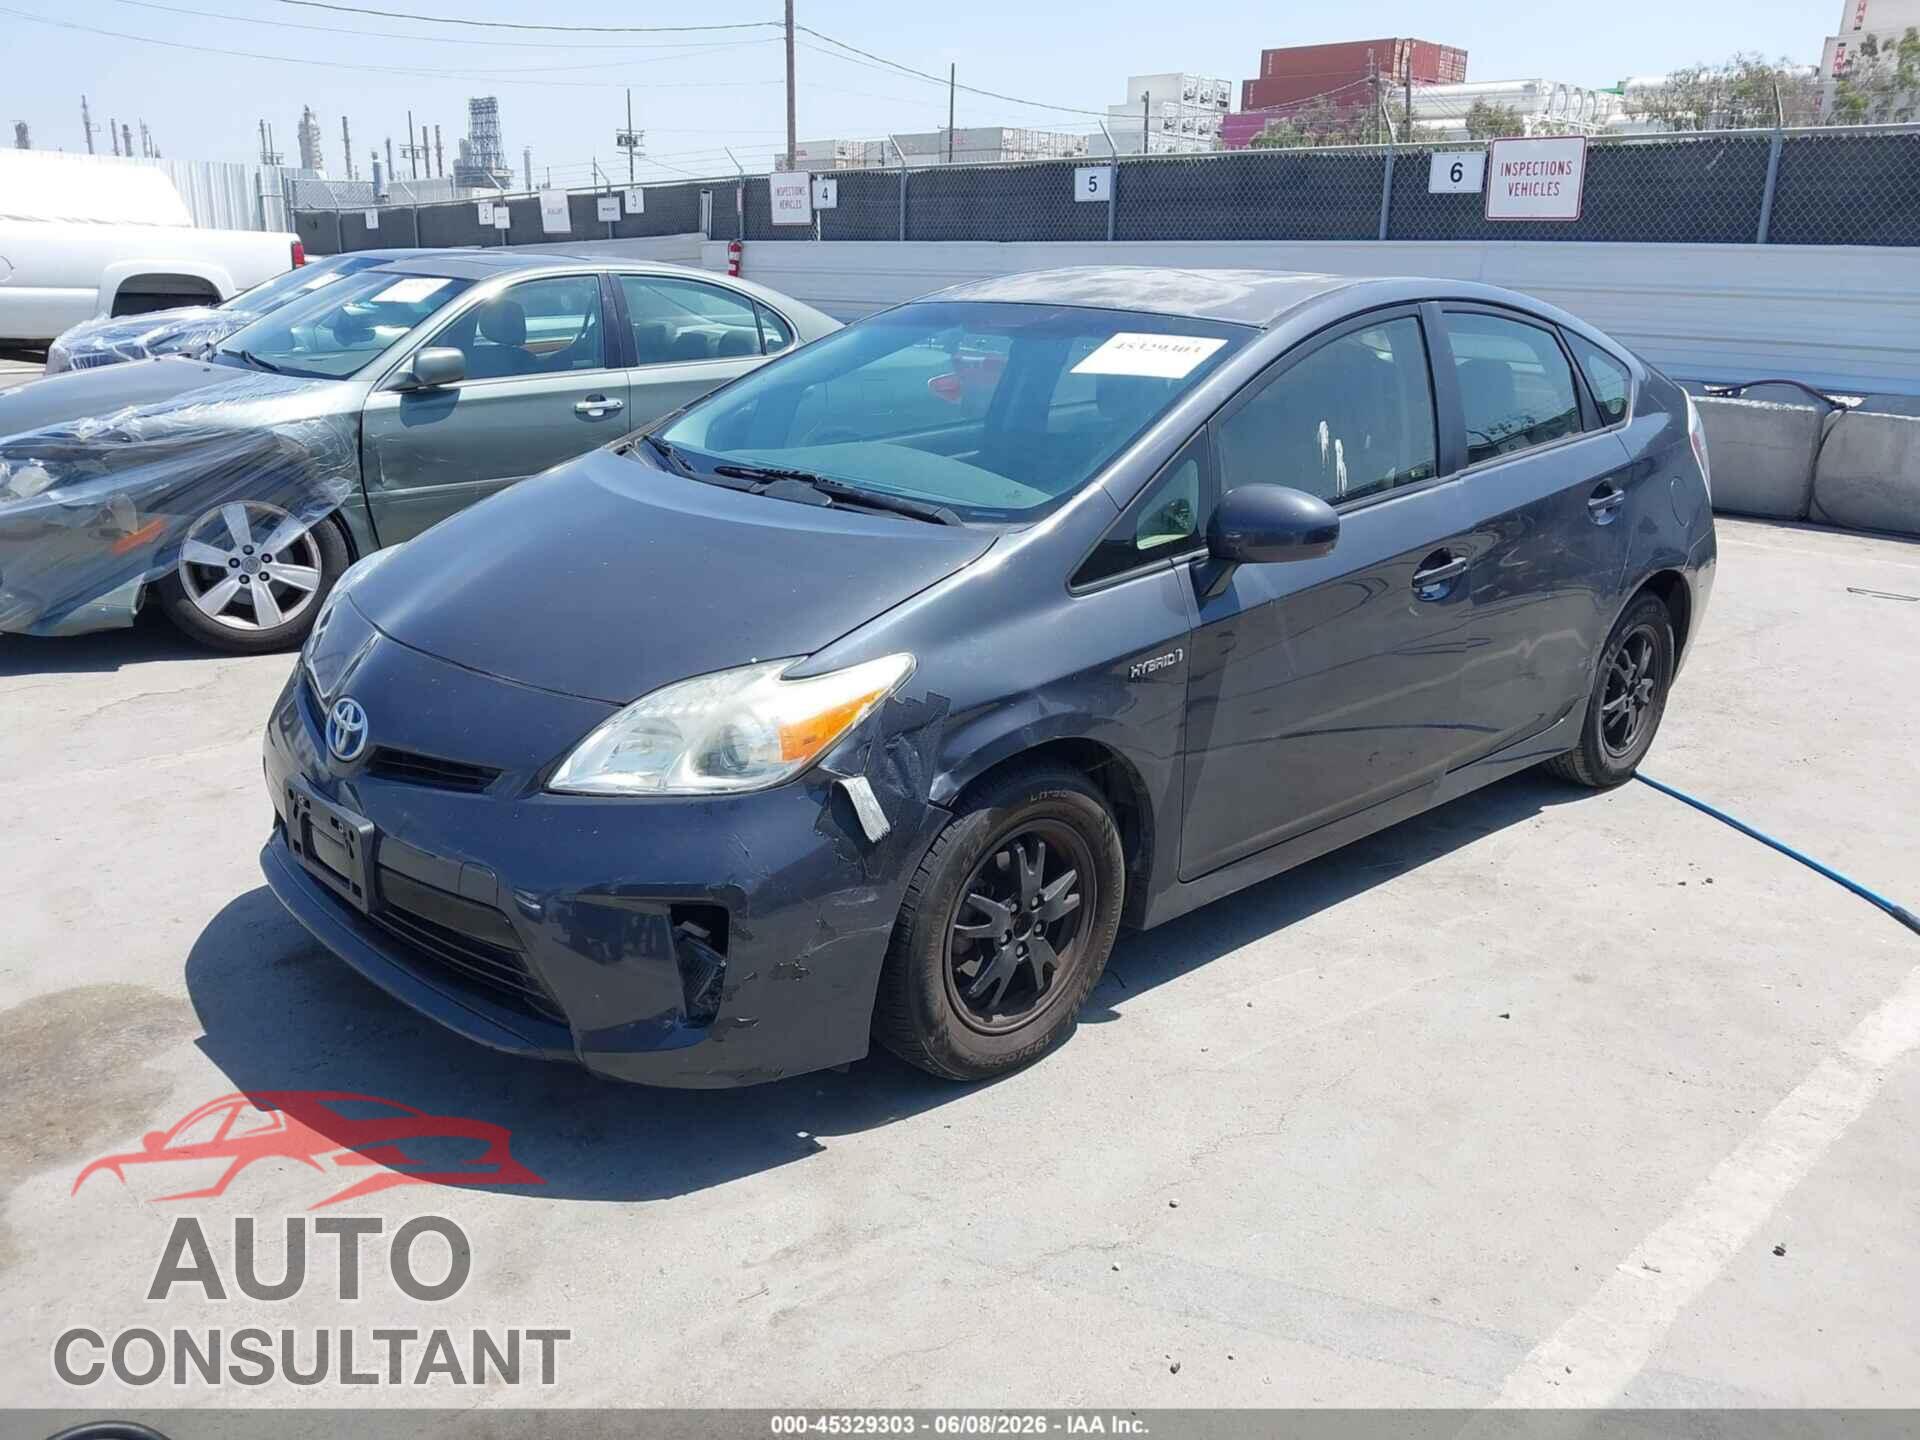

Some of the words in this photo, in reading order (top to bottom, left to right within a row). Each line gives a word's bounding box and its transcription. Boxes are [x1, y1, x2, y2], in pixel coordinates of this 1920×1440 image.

[1449, 162, 1464, 184] 6
[1500, 160, 1573, 177] INSPECTIONS
[1088, 175, 1098, 193] 5
[1508, 182, 1561, 197] VEHICLES
[822, 186, 829, 201] 4
[1129, 650, 1180, 678] HYBRID
